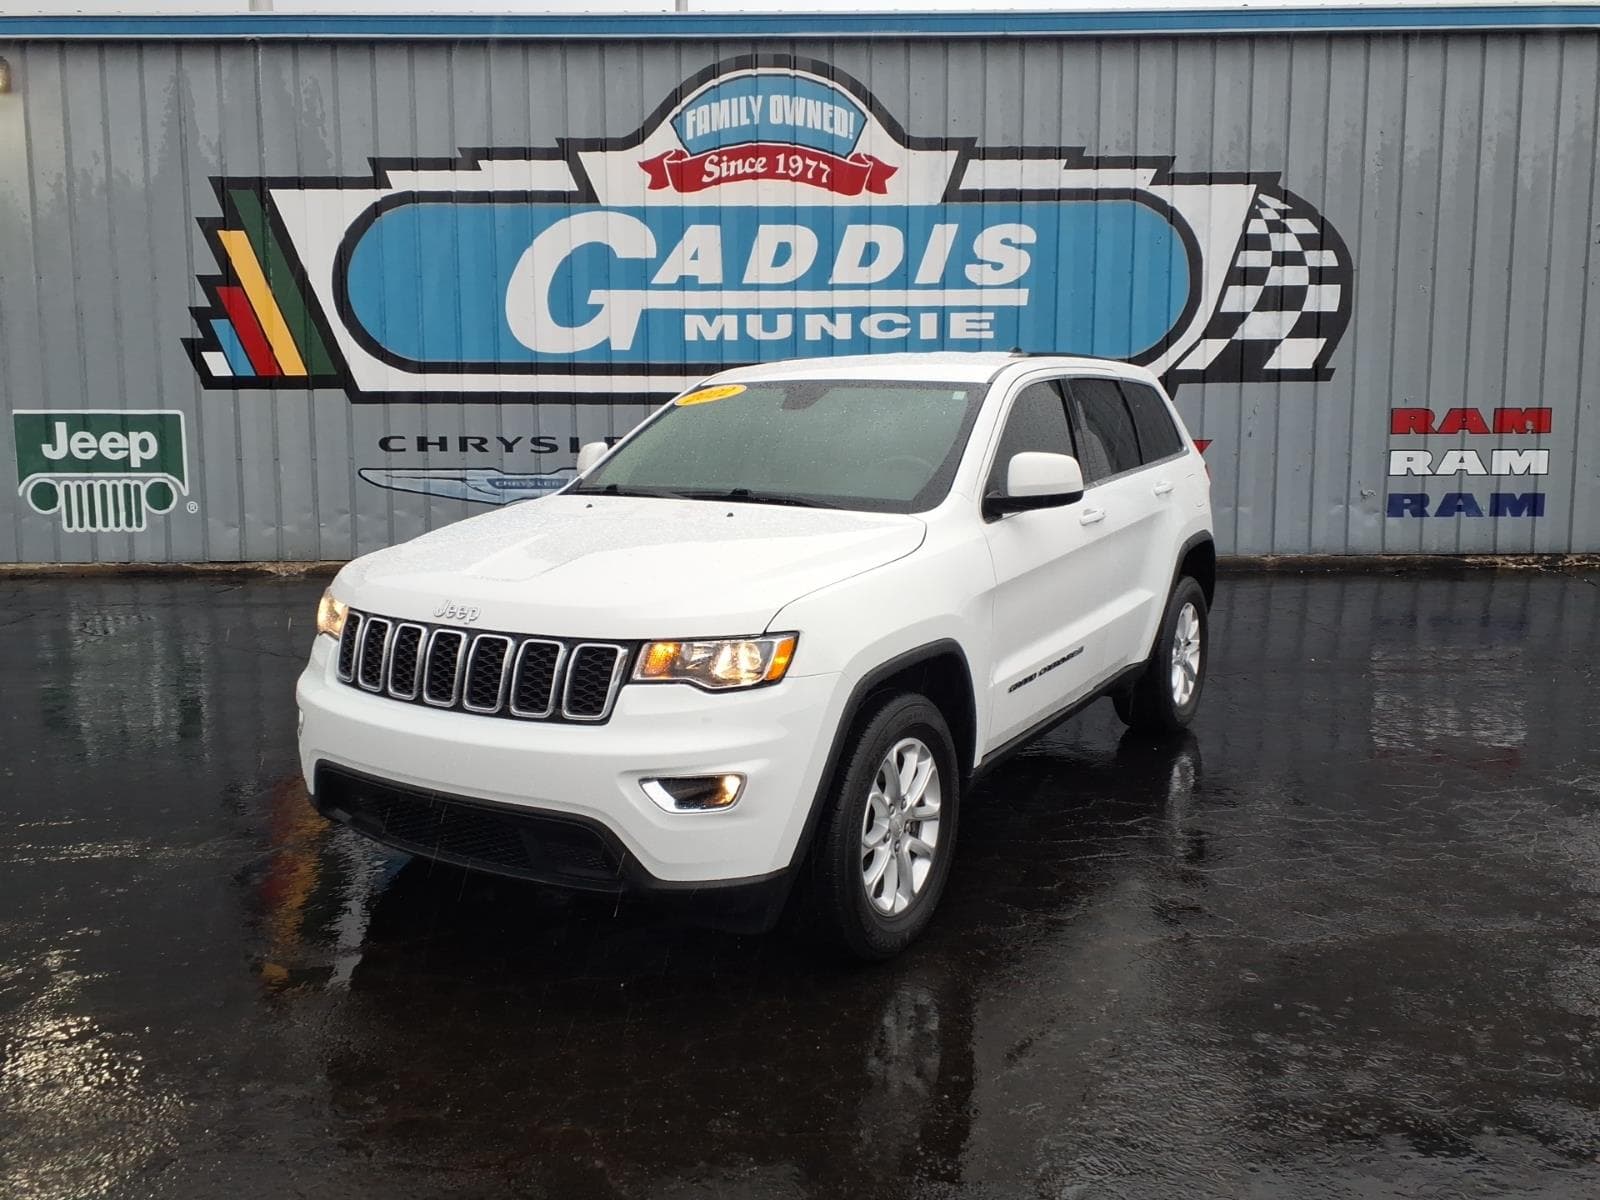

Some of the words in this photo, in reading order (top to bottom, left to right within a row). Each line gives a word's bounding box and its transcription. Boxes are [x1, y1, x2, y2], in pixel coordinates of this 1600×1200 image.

[686, 94, 763, 140] FAMILY
[769, 94, 854, 139] OWNED!
[702, 154, 768, 183] Since
[775, 153, 831, 183] 1977
[505, 211, 1037, 354] GADDIS
[684, 312, 995, 341] MUNCIE
[1391, 407, 1552, 434] RAM
[41, 421, 158, 468] Jeep
[1388, 448, 1550, 476] RAM
[1387, 492, 1546, 518] RAM
[432, 599, 481, 625] Jeep
